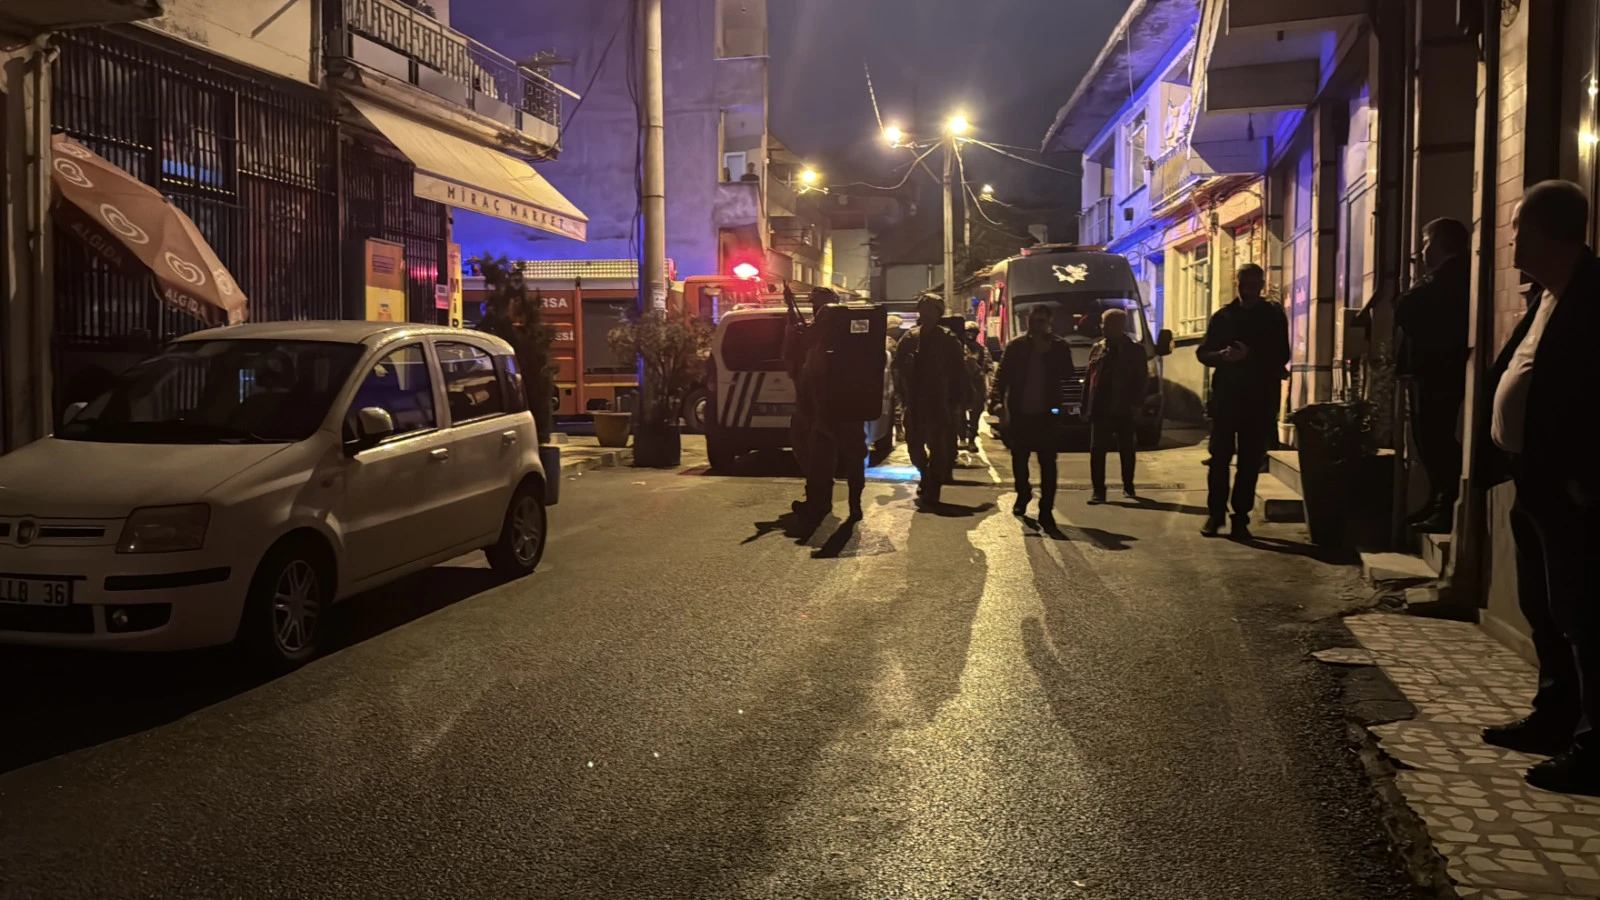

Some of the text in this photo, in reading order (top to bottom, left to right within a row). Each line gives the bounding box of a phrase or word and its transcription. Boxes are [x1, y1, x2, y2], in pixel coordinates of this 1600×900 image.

[447, 186, 564, 229] MİRAÇ MARKET
[69, 221, 122, 267] ALGIDA
[540, 297, 568, 308] RSA
[43, 583, 65, 604] 36
